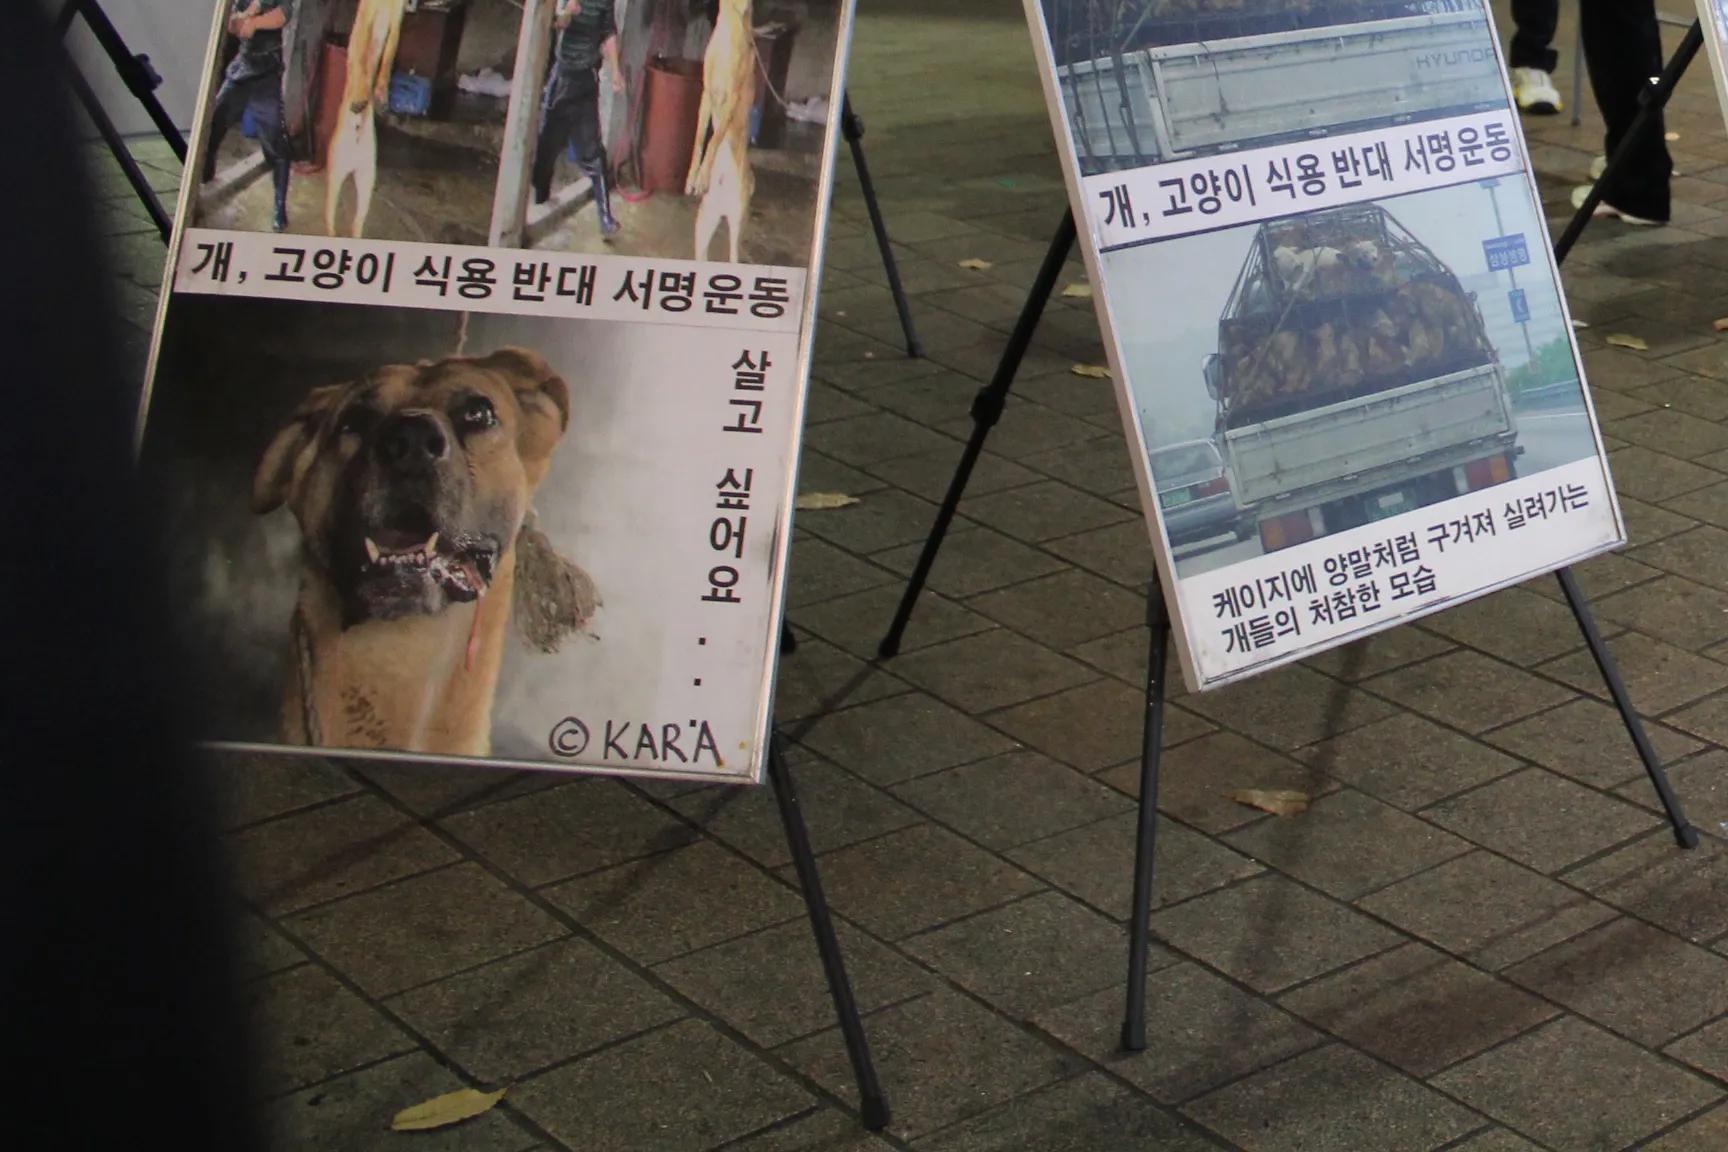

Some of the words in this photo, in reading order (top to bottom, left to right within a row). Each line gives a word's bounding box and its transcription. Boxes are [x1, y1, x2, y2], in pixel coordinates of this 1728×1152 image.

[1415, 46, 1496, 70] HYUNDA
[1099, 183, 1152, 229] 개,
[1157, 163, 1257, 217] 고양이
[1265, 153, 1326, 200] 식용
[1331, 139, 1395, 190] 반대
[1402, 120, 1513, 176] 서명운동
[191, 241, 248, 285] 개,
[264, 245, 397, 294] 고양이
[412, 254, 498, 300] 식용
[511, 260, 598, 307] 반대
[612, 268, 791, 320] 서명운동
[722, 348, 773, 434] 살고
[1211, 562, 1319, 621] 케이지에
[1323, 531, 1422, 588] 양말처럼
[1426, 507, 1498, 555] 구겨져
[1501, 483, 1591, 531] 실려가는
[1221, 604, 1302, 655] 개들의
[1309, 580, 1382, 628] 처참한
[1388, 562, 1438, 602] 모습
[602, 719, 725, 768] KARA
